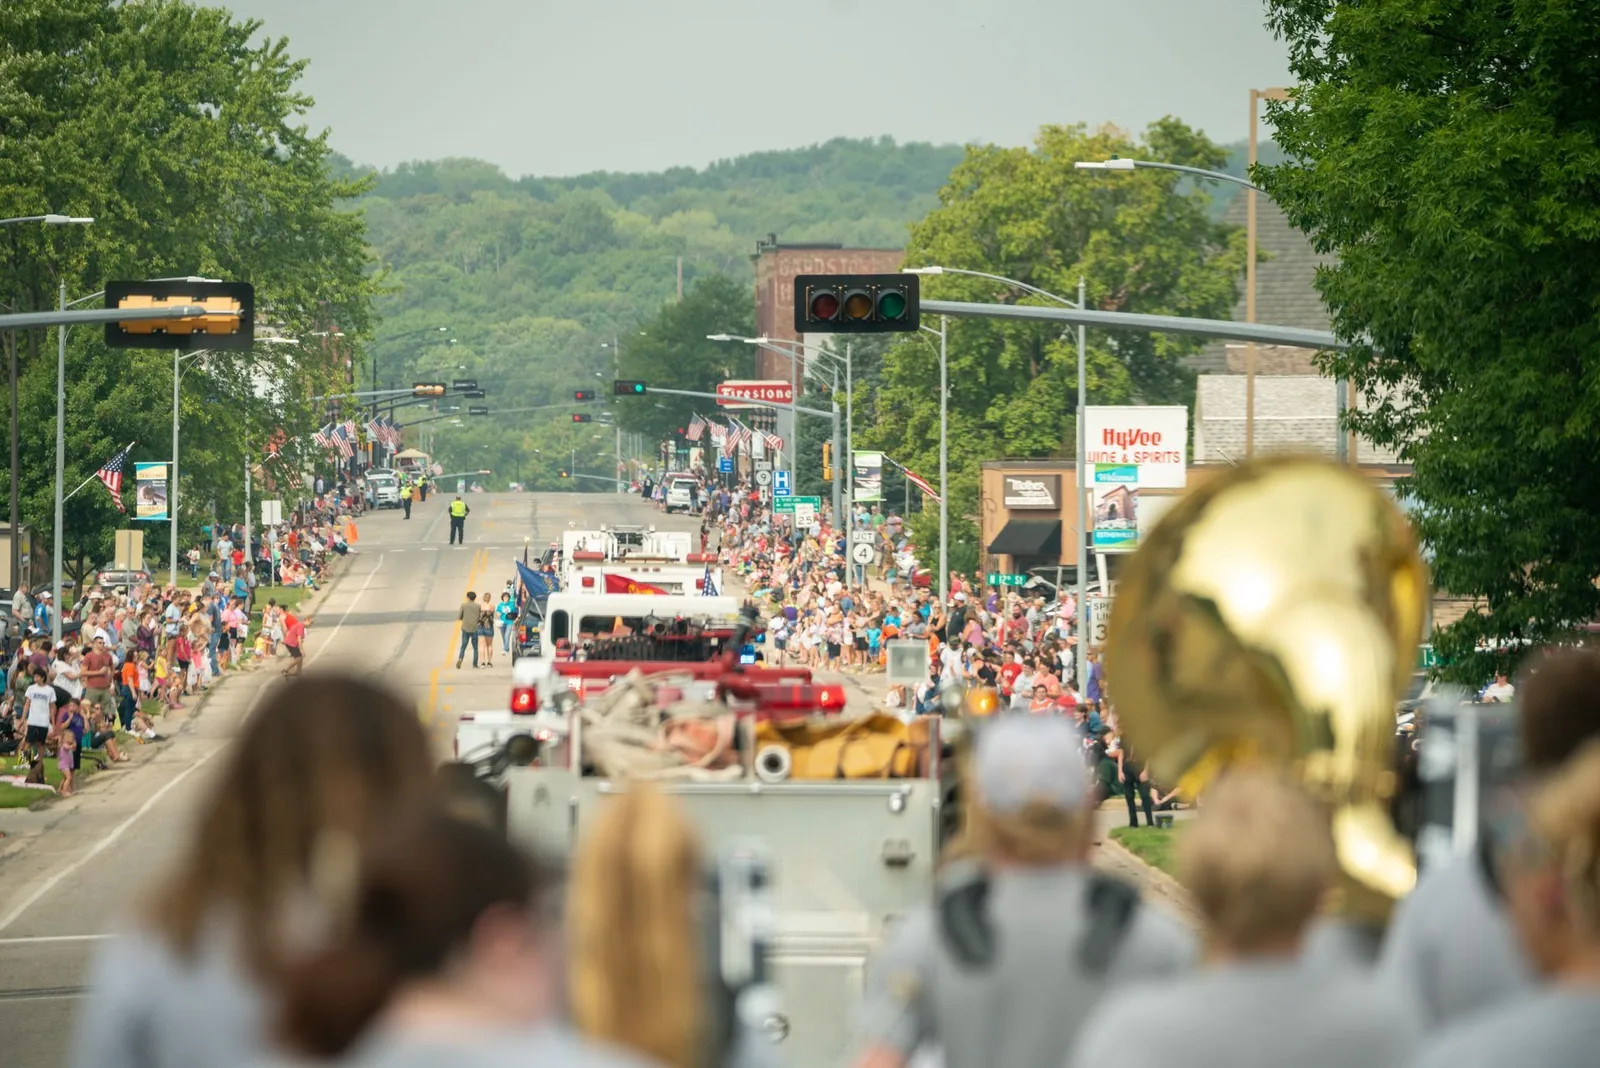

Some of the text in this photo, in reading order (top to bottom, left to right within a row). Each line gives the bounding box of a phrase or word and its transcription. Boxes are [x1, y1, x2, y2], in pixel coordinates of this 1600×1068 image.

[721, 387, 792, 400] Firestone
[1103, 428, 1162, 450] HyVee
[1121, 453, 1129, 463] &
[1134, 451, 1181, 463] SPIRITS
[760, 473, 767, 482] 9
[798, 515, 812, 525] 25
[858, 547, 868, 559] 4
[1093, 602, 1111, 611] SPE
